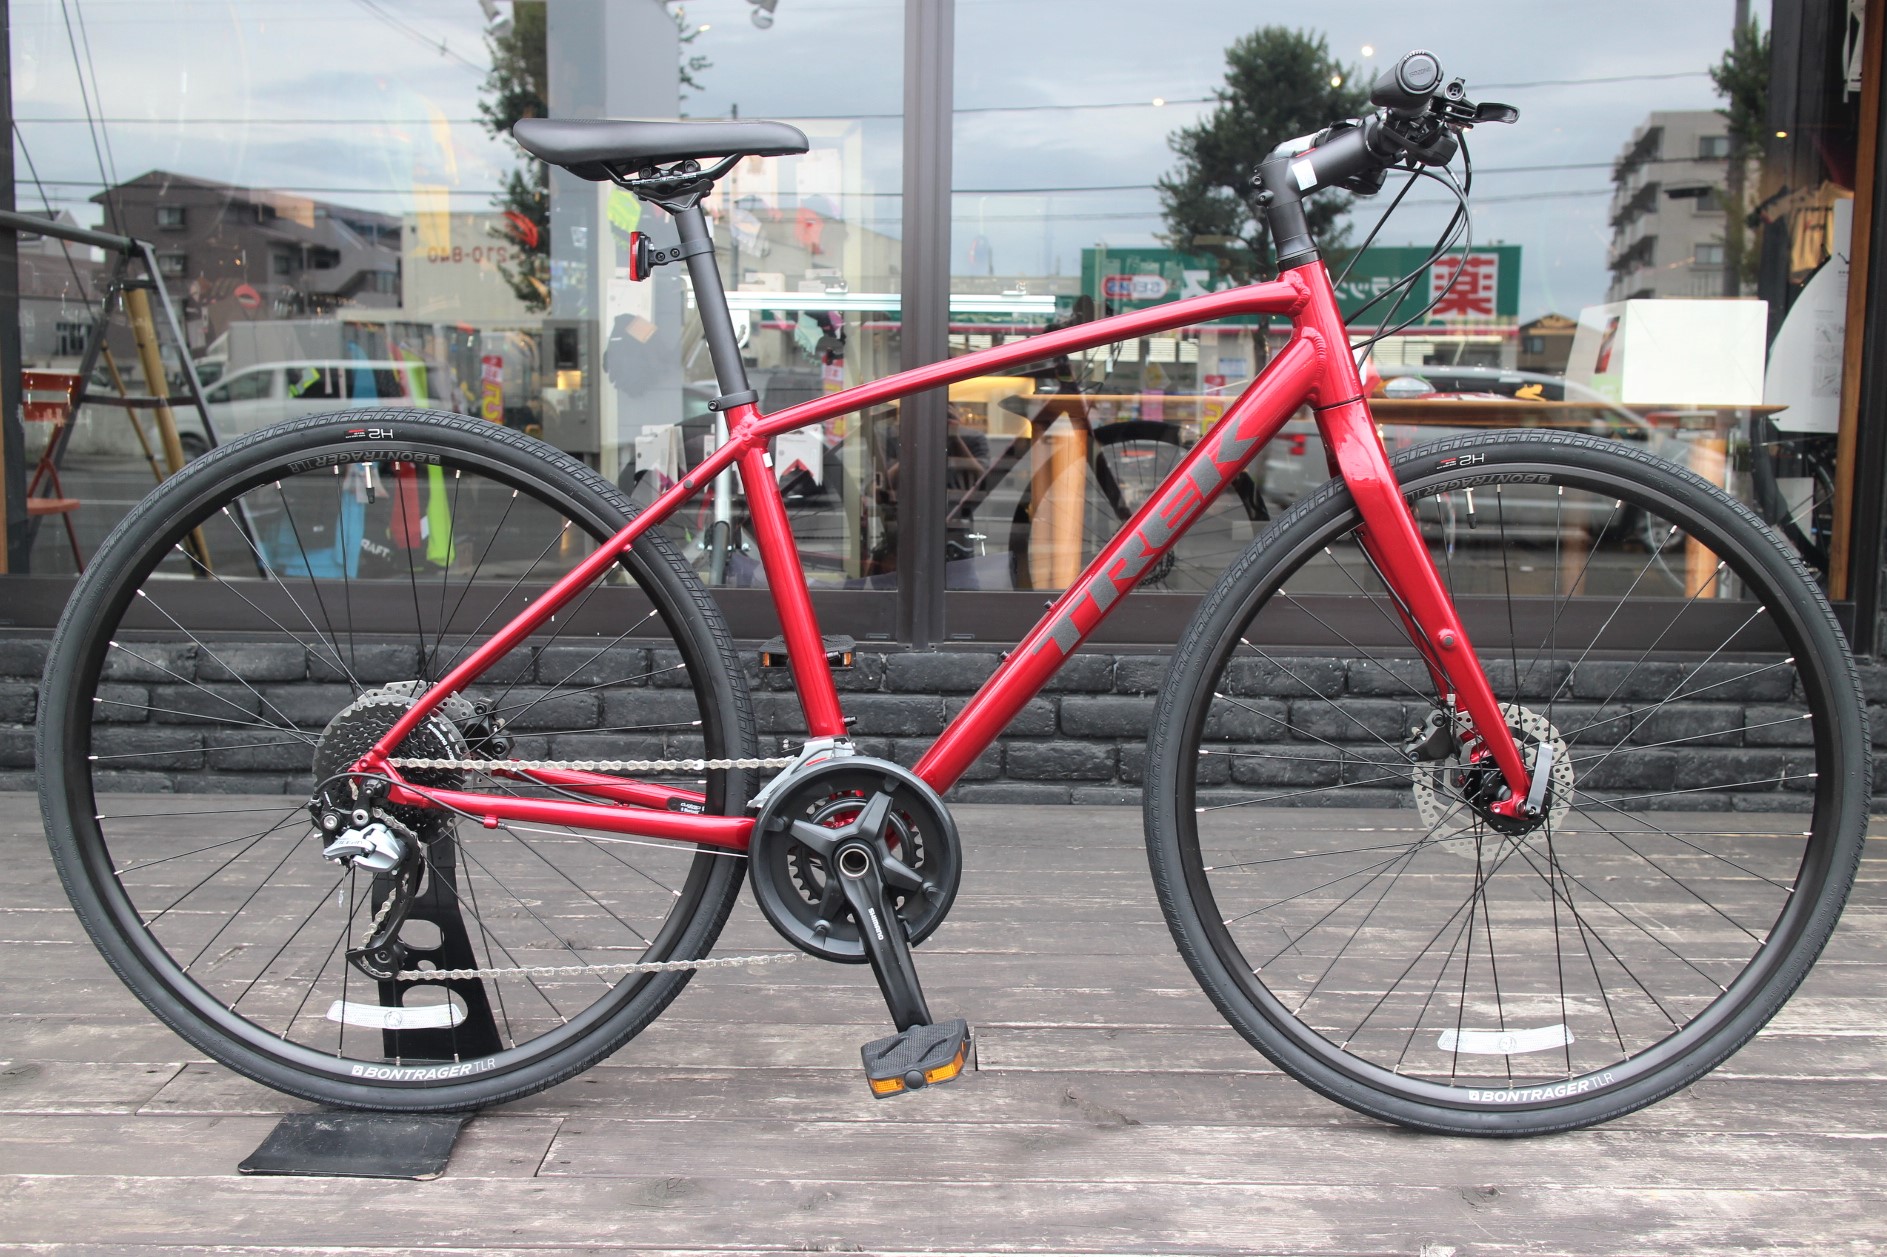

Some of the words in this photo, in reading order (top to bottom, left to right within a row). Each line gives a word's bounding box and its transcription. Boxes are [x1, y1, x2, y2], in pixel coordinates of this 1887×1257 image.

[368, 428, 394, 439] H2
[315, 450, 428, 467] BONTRAGER
[1459, 453, 1485, 466] H2
[1424, 473, 1537, 496] BONTRAGER
[1032, 415, 1260, 656] TREK
[867, 907, 884, 941] SHIMANO
[363, 1063, 473, 1081] BONTRAGER
[473, 1058, 496, 1073] TLR
[1481, 1080, 1590, 1102] BONTRAGER
[1588, 1072, 1615, 1088] TLR
